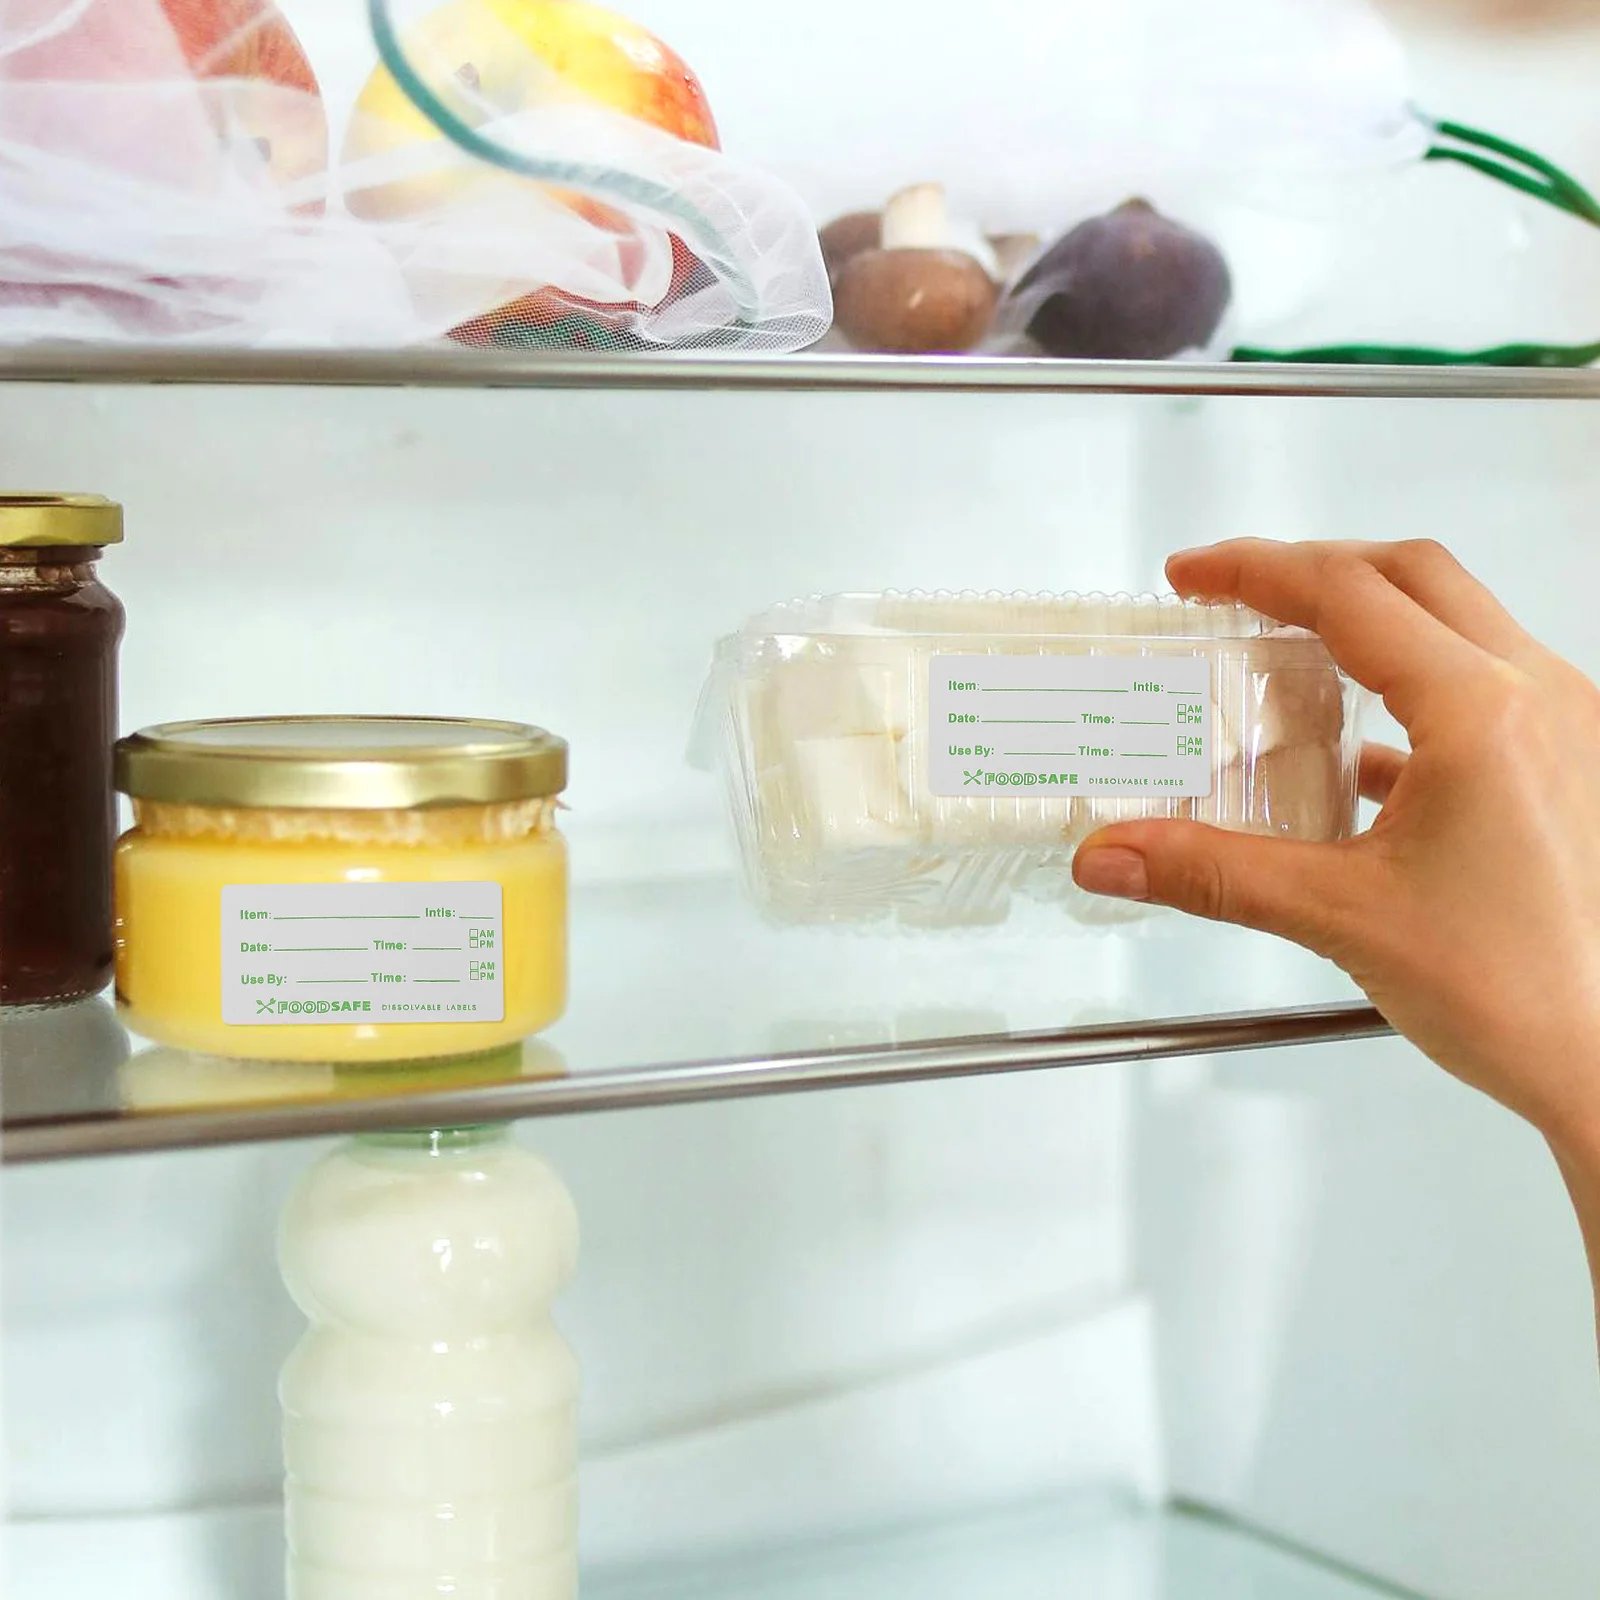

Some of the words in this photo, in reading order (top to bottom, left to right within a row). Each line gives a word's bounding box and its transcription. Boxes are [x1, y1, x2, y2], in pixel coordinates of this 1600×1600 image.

[948, 680, 980, 691] Item:
[1187, 704, 1203, 713] AM
[948, 713, 980, 724] Date:
[1081, 713, 1115, 724] Time:
[1187, 715, 1203, 724] PM
[1187, 737, 1203, 746] AM
[948, 745, 972, 756] Use
[974, 745, 995, 758] By:
[1078, 746, 1114, 757] Time:
[1187, 747, 1203, 756] PM
[984, 772, 1079, 786] FOODSAFE
[1088, 777, 1149, 786] DISSOLVABLE
[1153, 778, 1184, 786] LABELS
[240, 909, 272, 920] Item:
[479, 929, 495, 938] AM
[240, 942, 272, 953] Date:
[373, 940, 407, 951] Time:
[479, 939, 495, 949] PM
[479, 961, 495, 970] AM
[241, 974, 264, 985] Use
[267, 974, 287, 987] By:
[371, 972, 406, 983] Time:
[479, 971, 495, 981] PM
[277, 1000, 372, 1014] FOODSAFE
[381, 1003, 441, 1011] DISSOLVABLE
[446, 1003, 477, 1011] LABELS
